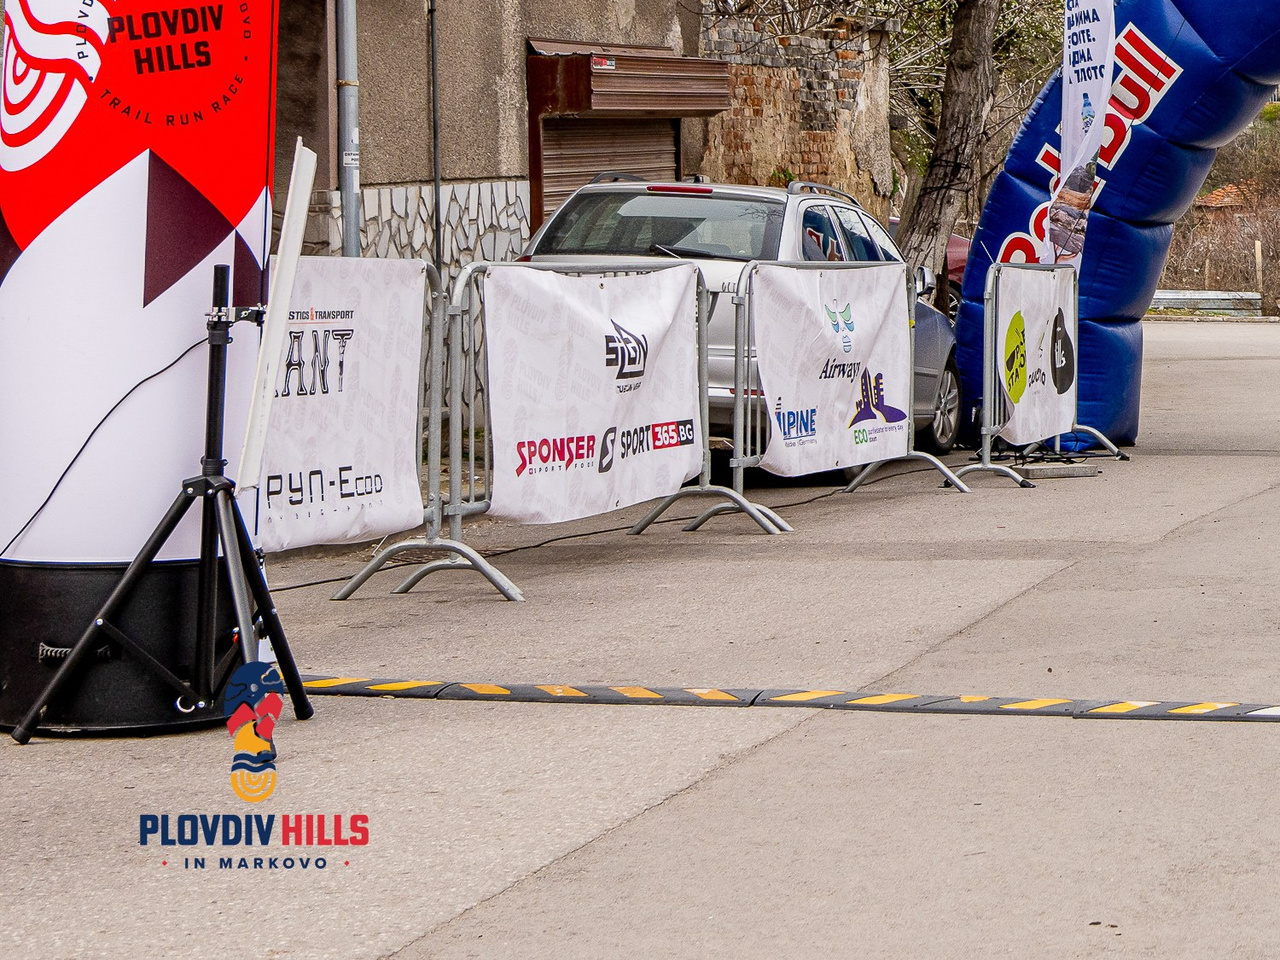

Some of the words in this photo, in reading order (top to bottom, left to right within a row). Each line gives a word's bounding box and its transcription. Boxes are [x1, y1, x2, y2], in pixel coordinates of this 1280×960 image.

[107, 4, 223, 43] PLOVDIV
[134, 41, 212, 74] HILLS
[100, 89, 152, 124] TRAIL
[166, 111, 203, 126] RUN
[211, 74, 244, 113] RACE
[288, 311, 309, 320] STICS
[315, 311, 354, 320] TRANSPORT
[275, 329, 354, 398] ANT
[516, 435, 596, 477] SPONSER
